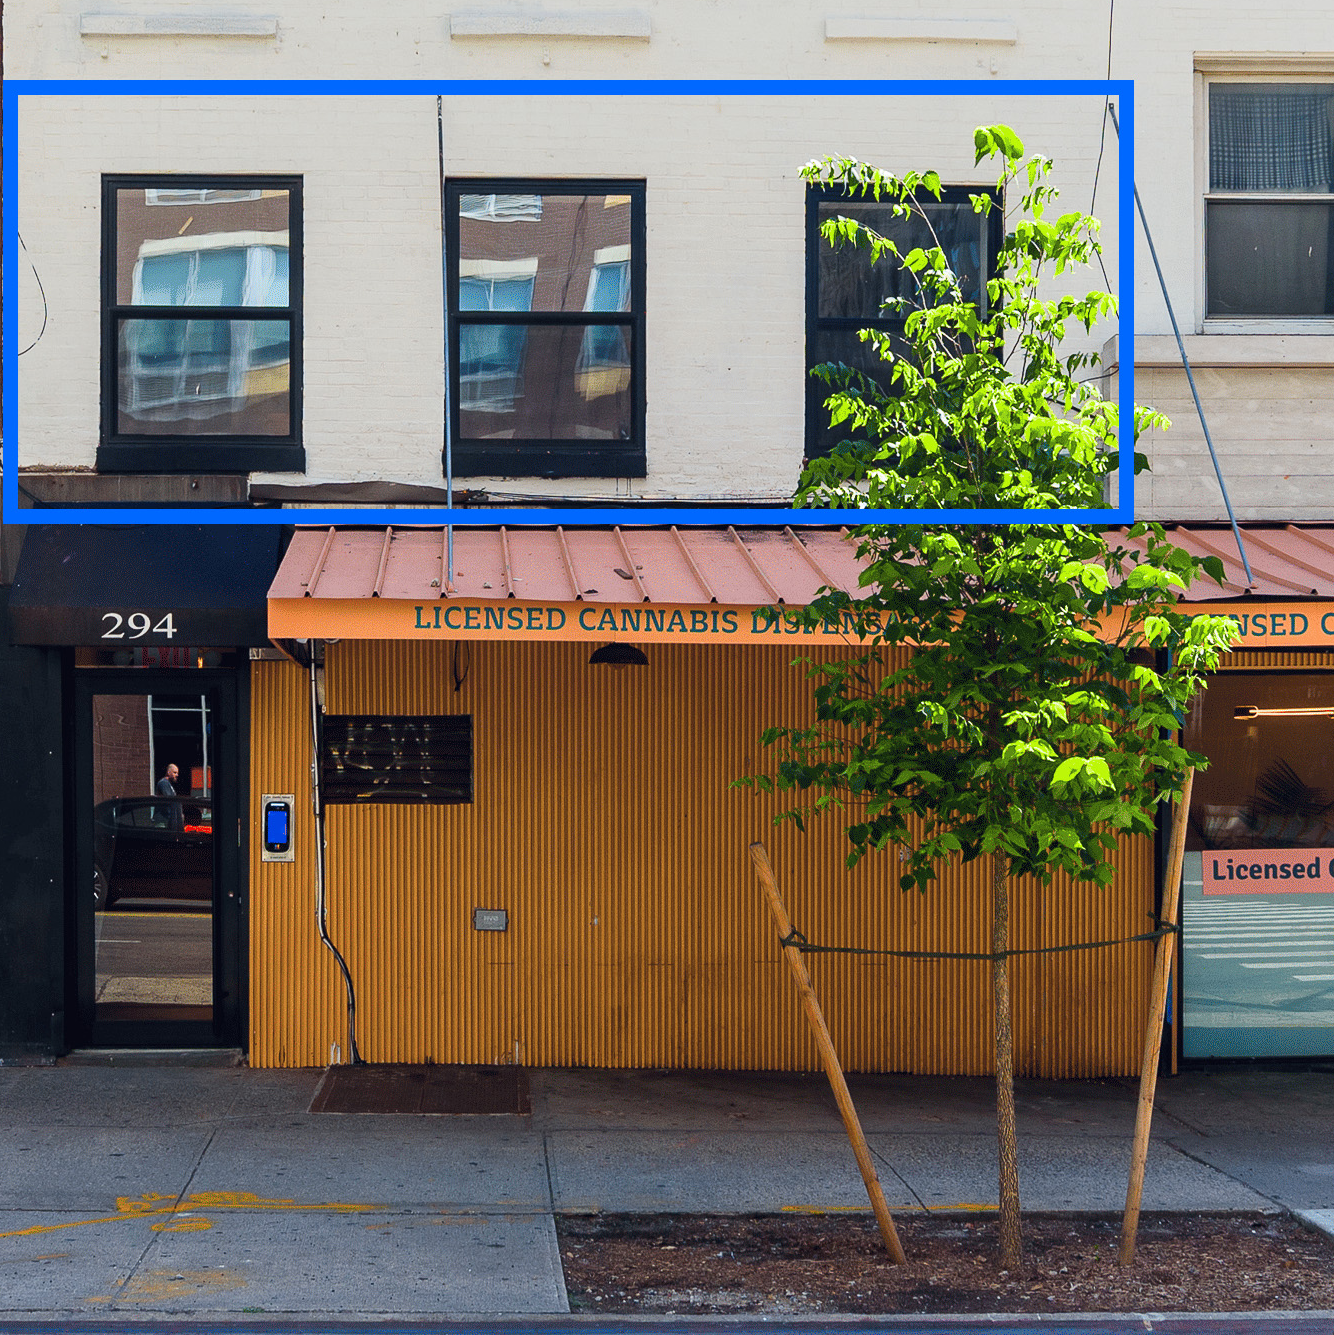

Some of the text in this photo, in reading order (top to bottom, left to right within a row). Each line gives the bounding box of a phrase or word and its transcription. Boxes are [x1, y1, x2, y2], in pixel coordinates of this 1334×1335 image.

[101, 612, 177, 639] 294
[414, 606, 566, 631] LICENSED
[578, 608, 738, 634] CANNABIS
[1212, 856, 1321, 881] Licensed
